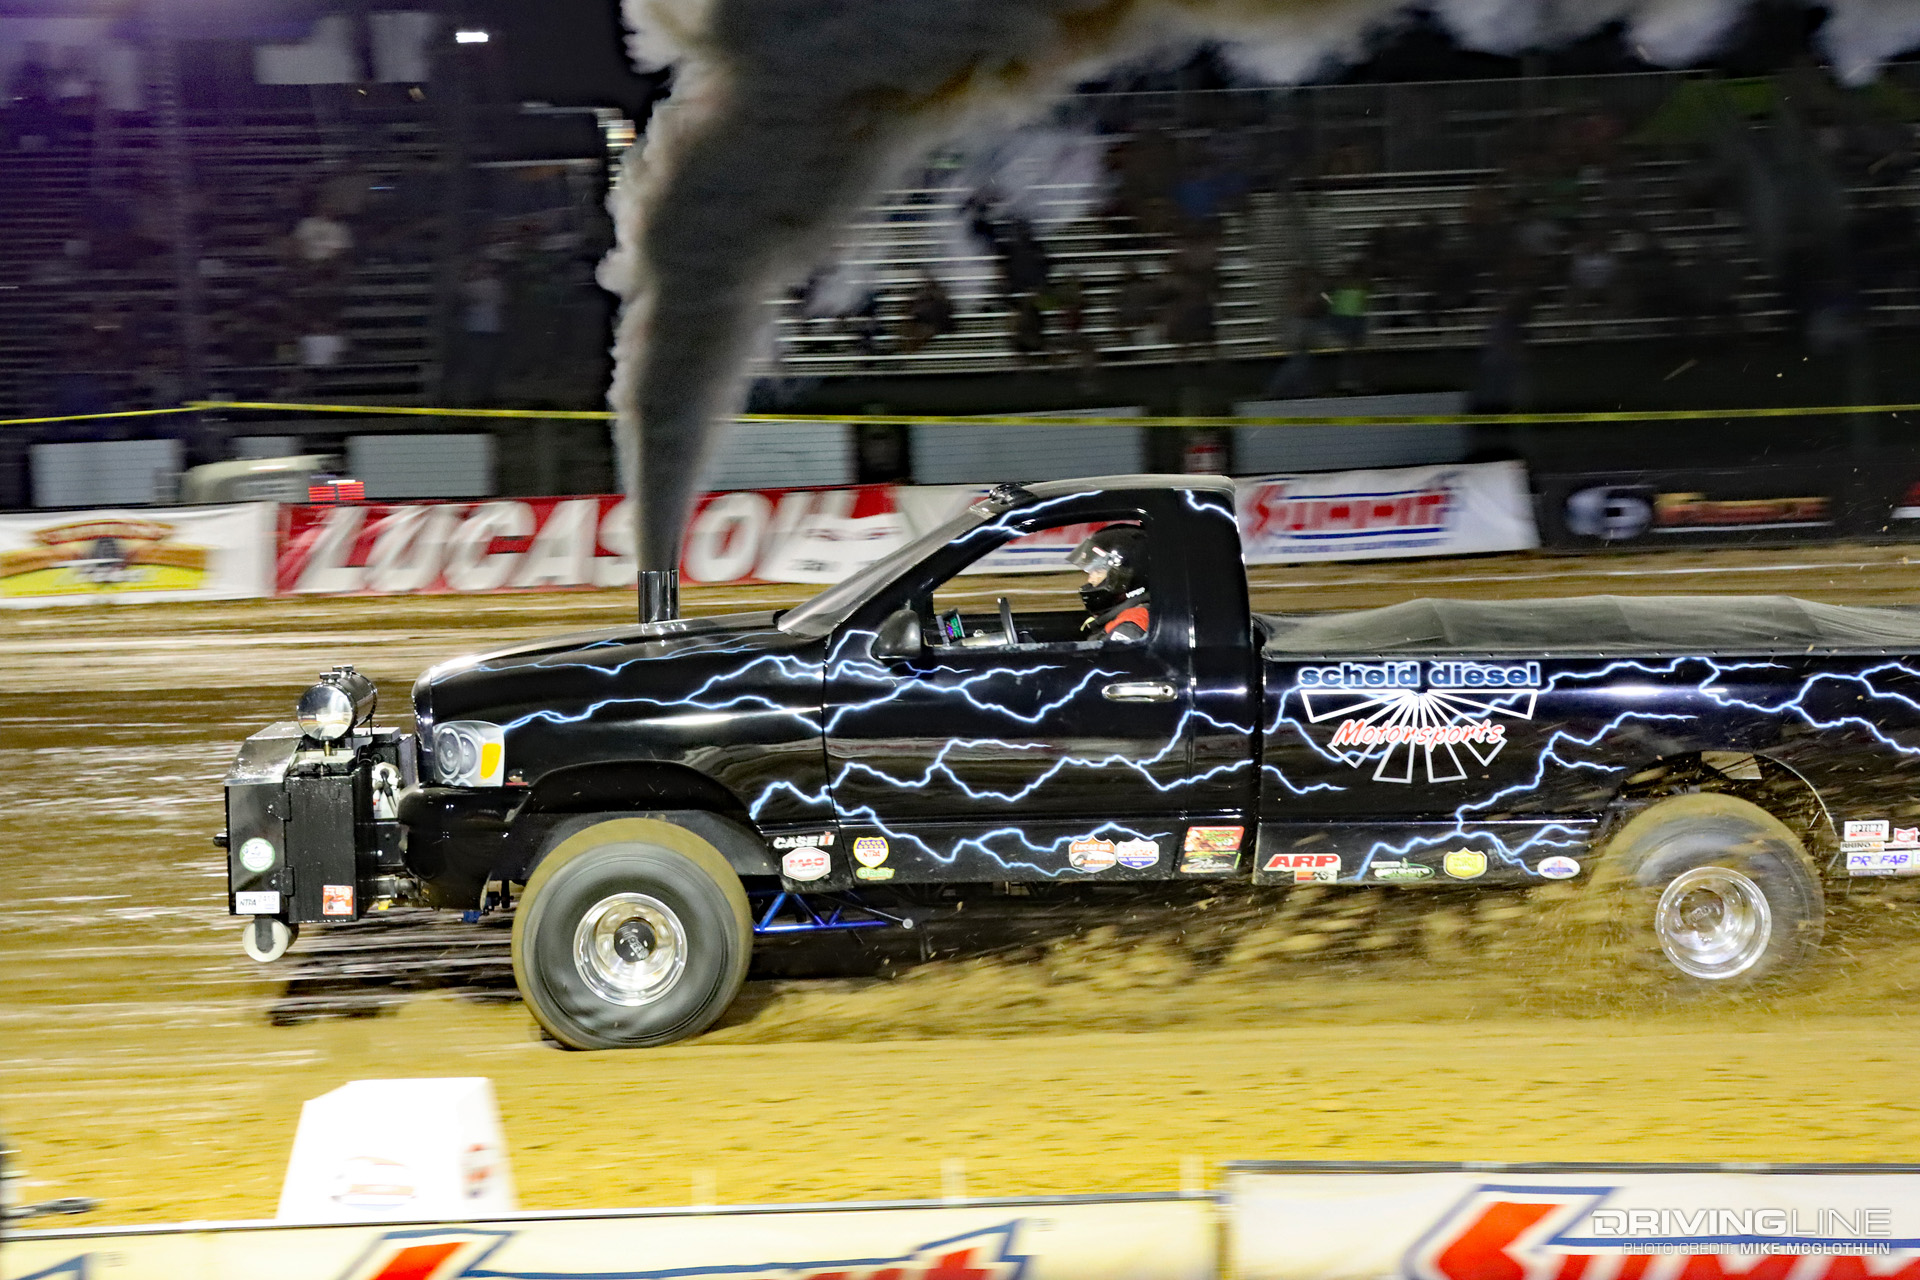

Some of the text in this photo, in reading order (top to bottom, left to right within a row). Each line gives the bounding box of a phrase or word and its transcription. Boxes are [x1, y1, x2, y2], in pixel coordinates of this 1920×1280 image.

[1299, 662, 1541, 687] scheid diesel
[1332, 719, 1506, 752] Motorsports
[773, 836, 818, 849] CASE
[1268, 856, 1338, 868] ARP
